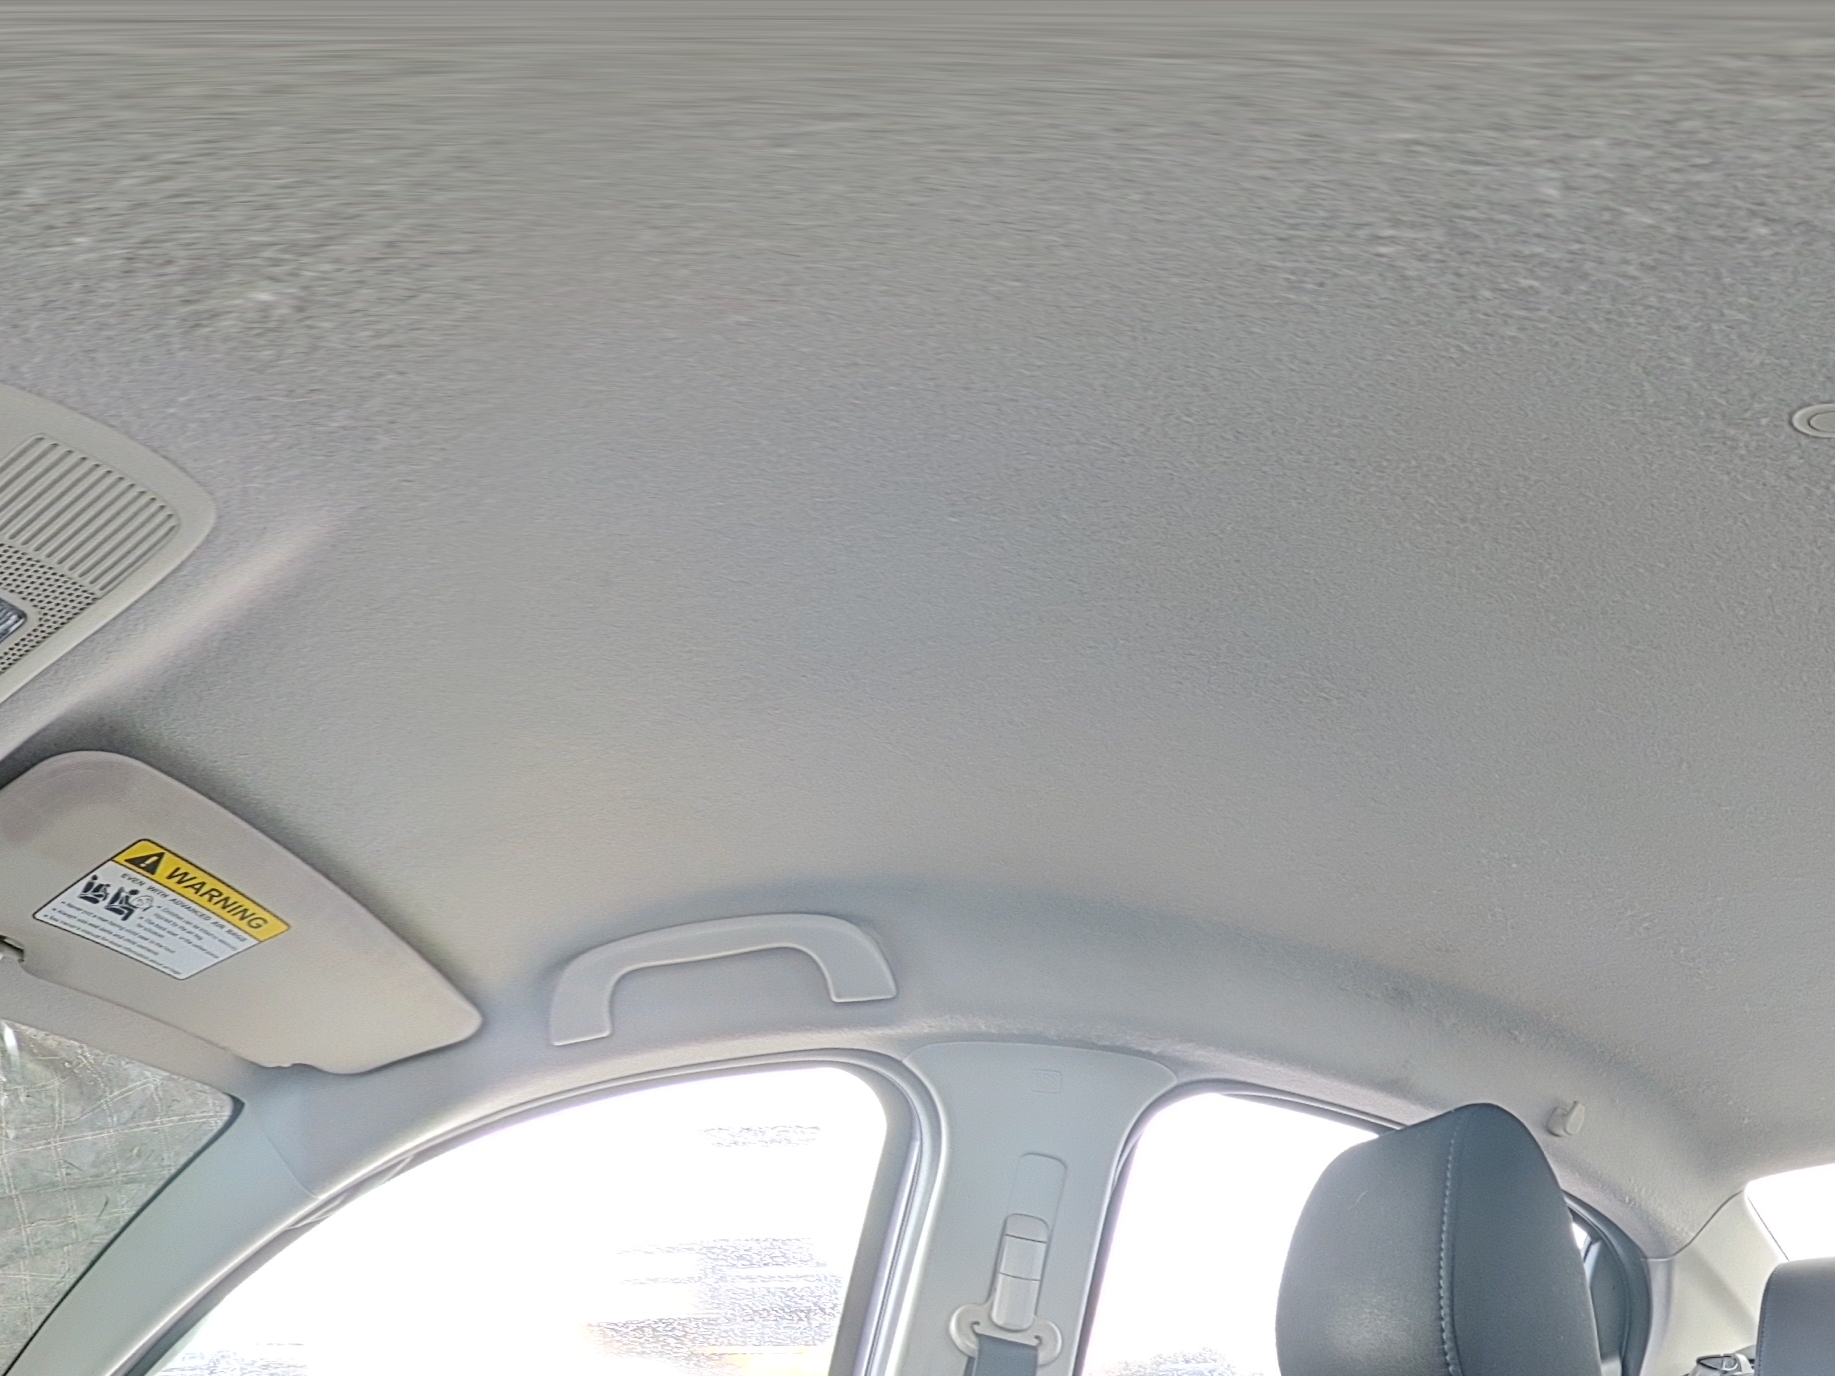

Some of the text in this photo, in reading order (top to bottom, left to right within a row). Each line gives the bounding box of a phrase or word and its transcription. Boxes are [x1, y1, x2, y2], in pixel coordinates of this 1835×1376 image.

[121, 873, 145, 886] EVEN
[147, 883, 170, 898] WITH
[169, 898, 212, 921] ADVANCED
[166, 867, 268, 929] WARNING
